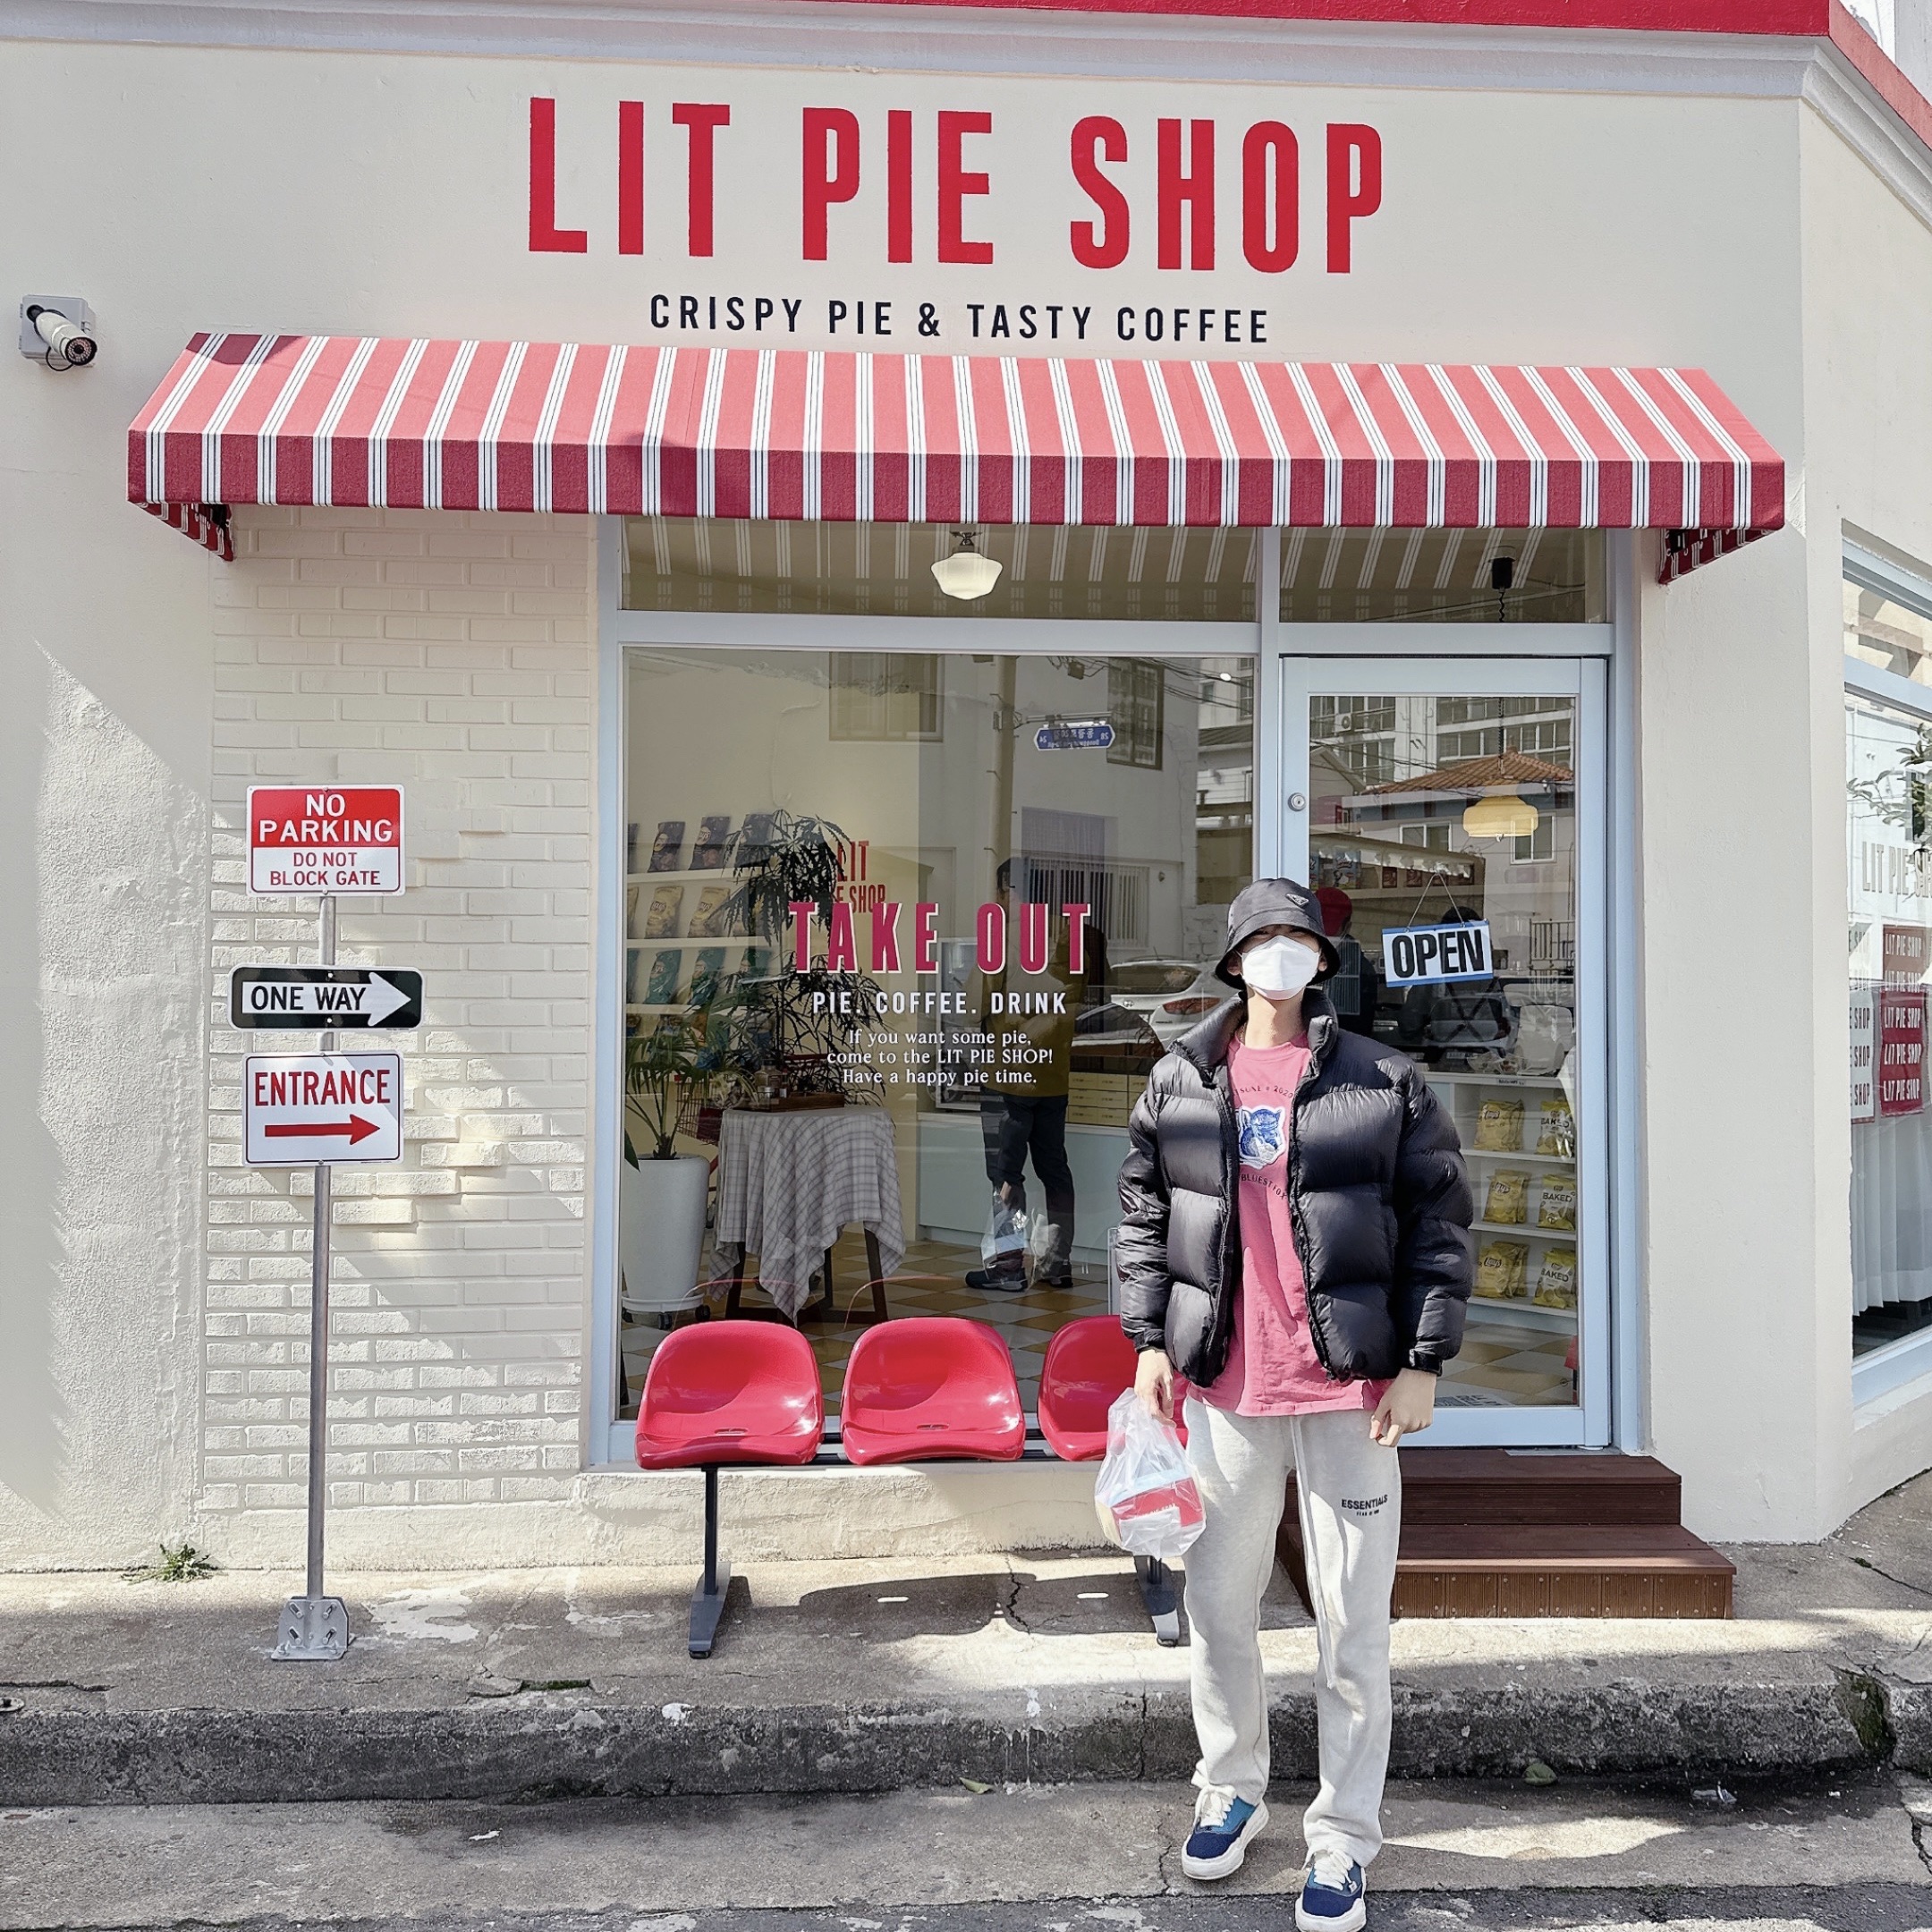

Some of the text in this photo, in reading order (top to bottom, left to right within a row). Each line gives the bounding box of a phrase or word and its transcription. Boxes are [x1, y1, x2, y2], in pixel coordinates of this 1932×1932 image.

[529, 97, 1382, 275] LIT PIE SHOP
[649, 293, 1269, 343] CRISPY PIE & TASTY COFFEE
[306, 794, 346, 818] NO
[258, 819, 394, 843] PARKING
[293, 852, 358, 867] DO NOT
[837, 841, 869, 883] LIT
[1862, 841, 1932, 898] LIT PIE SH
[270, 871, 380, 886] BLOCK GATE
[789, 902, 1090, 974] TAKE OUT
[1392, 929, 1486, 978] OPEN
[250, 986, 366, 1011] ONE WAY
[813, 992, 1067, 1014] PIE. COFFEE. DRINK
[849, 1030, 1031, 1047] If you want some pie,
[827, 1049, 1053, 1063] come to the LIT PIE SHOP!
[255, 1070, 391, 1106] ENTRANCE
[843, 1070, 1037, 1086] Have a happy pie time.
[1883, 1080, 1895, 1101] LIT
[1896, 1080, 1905, 1100] PIE
[1241, 1174, 1273, 1188] BLUEST
[1543, 1192, 1572, 1203] BAKED
[1342, 1494, 1388, 1510] ESSENTIALS
